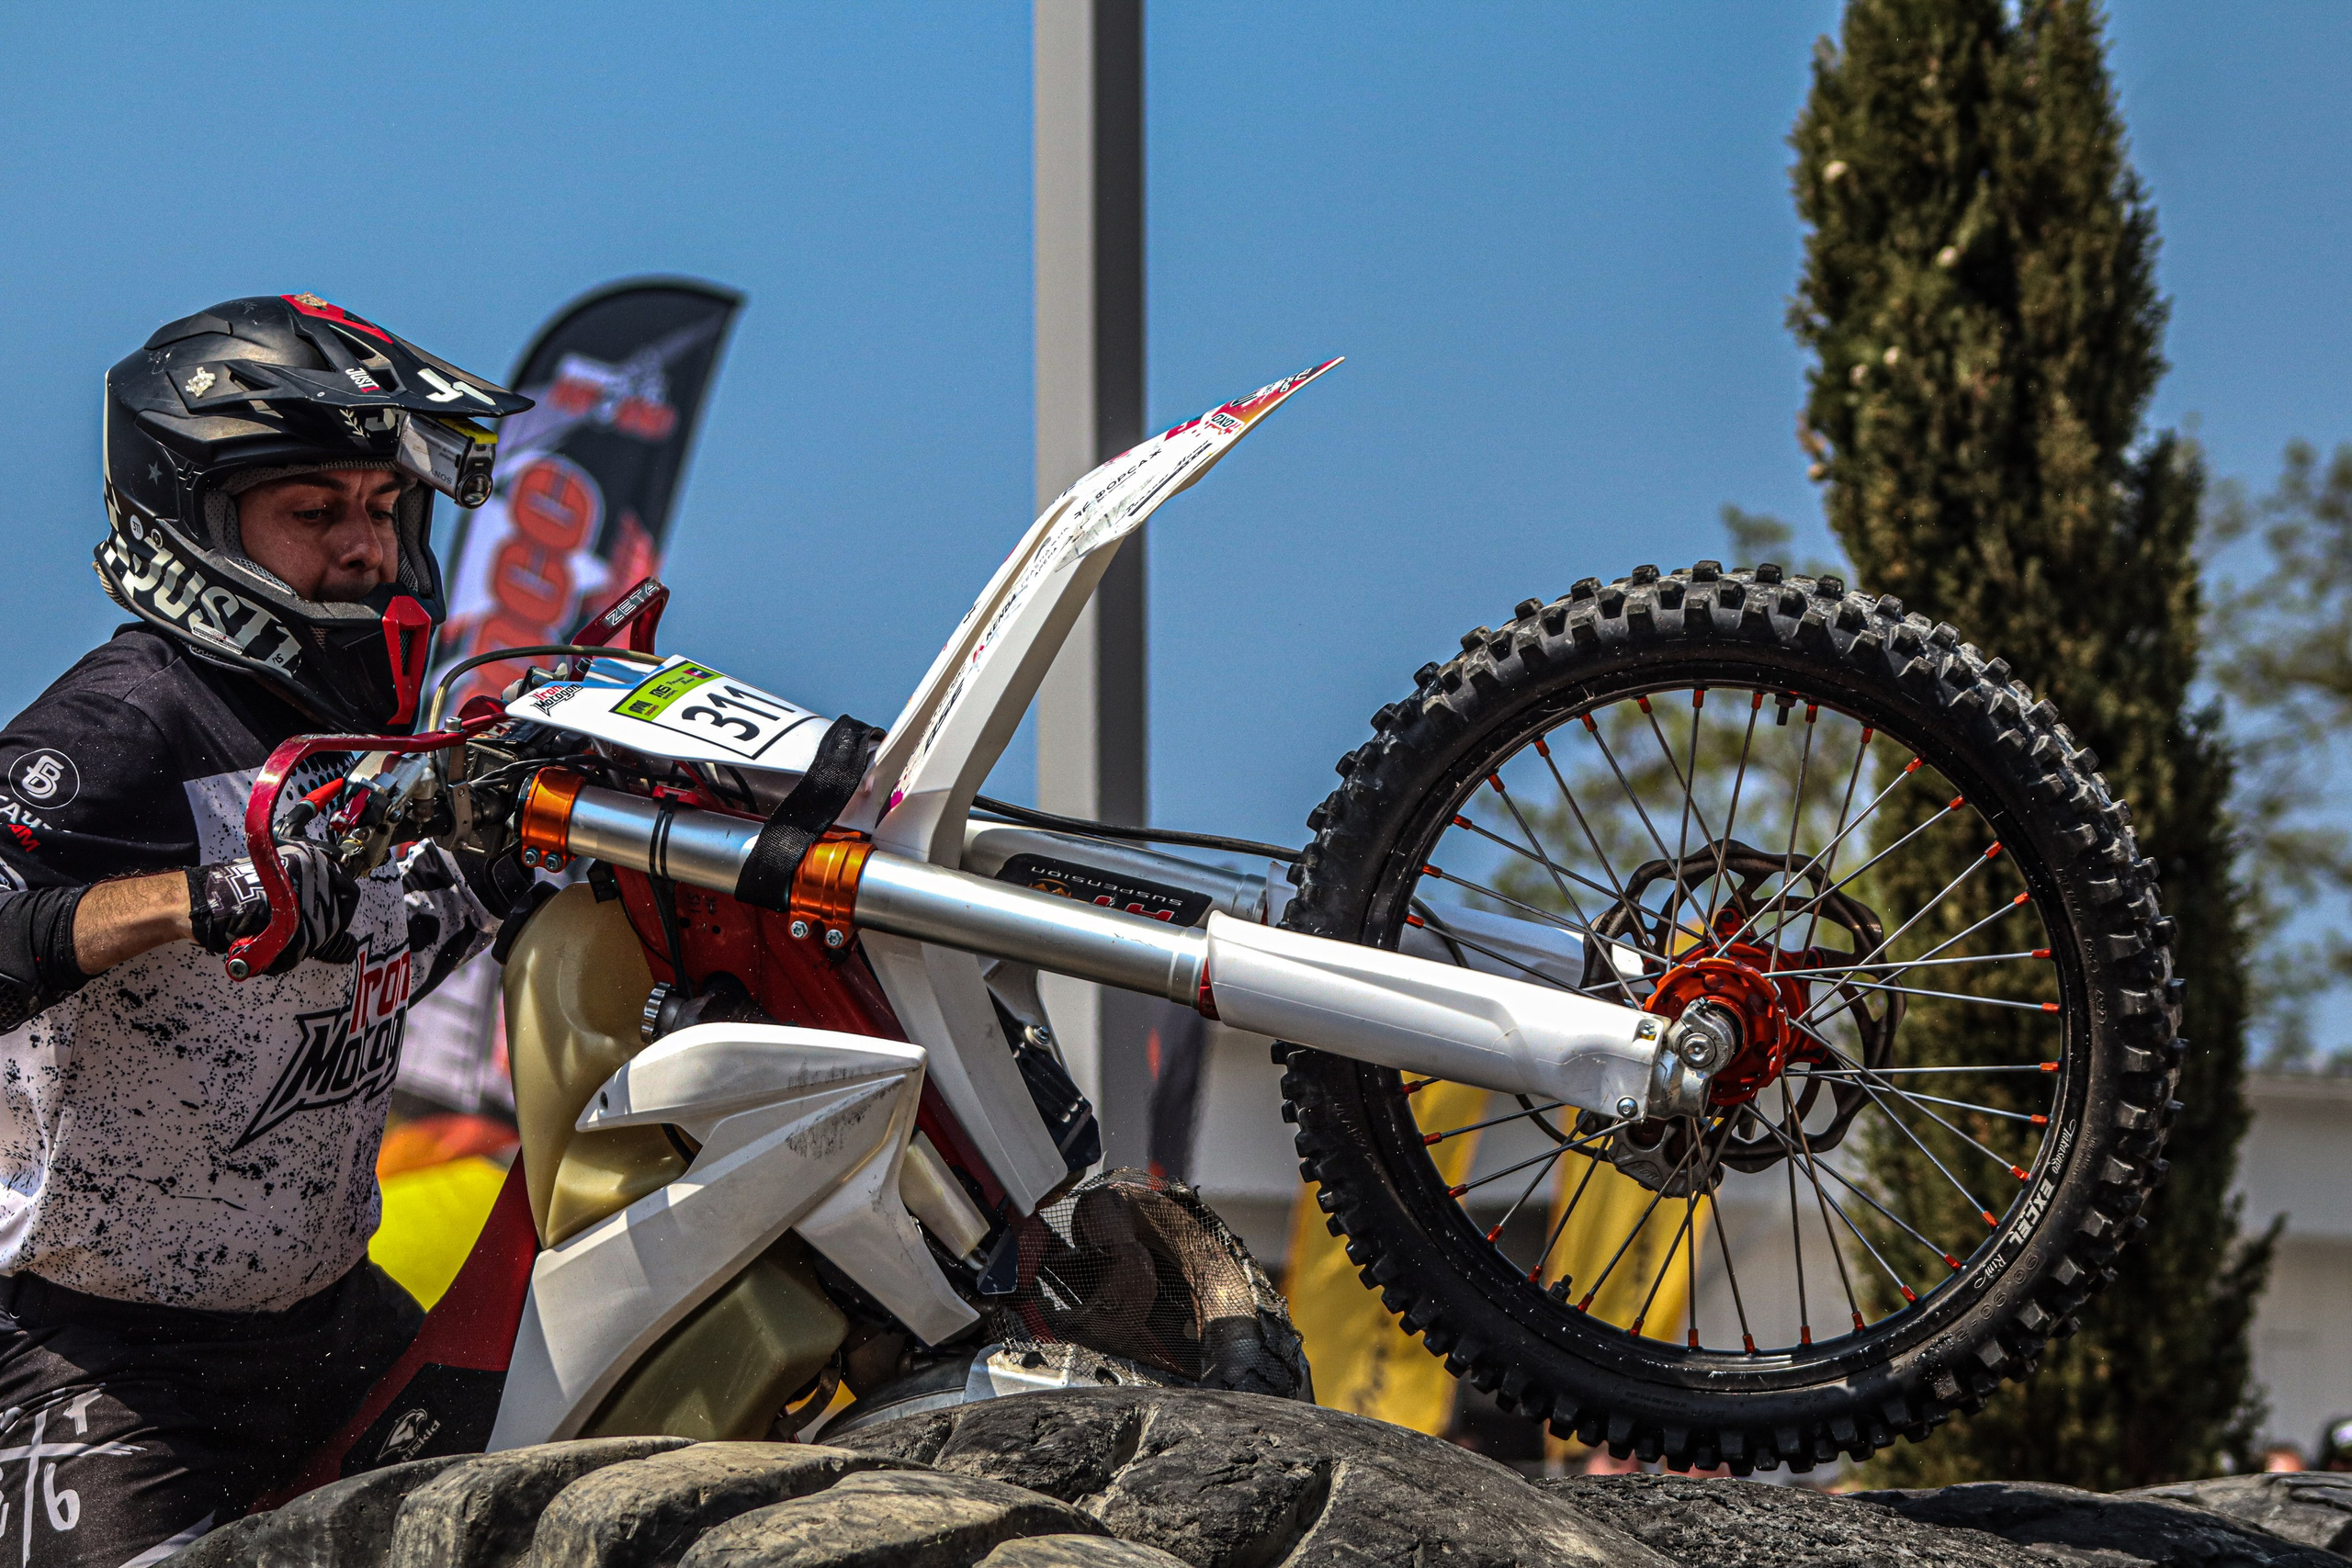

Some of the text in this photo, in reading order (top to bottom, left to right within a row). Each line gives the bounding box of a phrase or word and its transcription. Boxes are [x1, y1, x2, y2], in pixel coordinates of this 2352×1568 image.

[429, 468, 453, 485] SONY
[1094, 447, 1162, 500] ФОРСАЖ
[605, 582, 661, 626] ZETA
[986, 593, 1017, 641] KENDA
[534, 683, 563, 701] Iron
[681, 685, 797, 742] 311
[2052, 1118, 2077, 1175] Takasago
[2008, 1178, 2055, 1245] EXCEL
[1973, 1252, 2007, 1289] Rim
